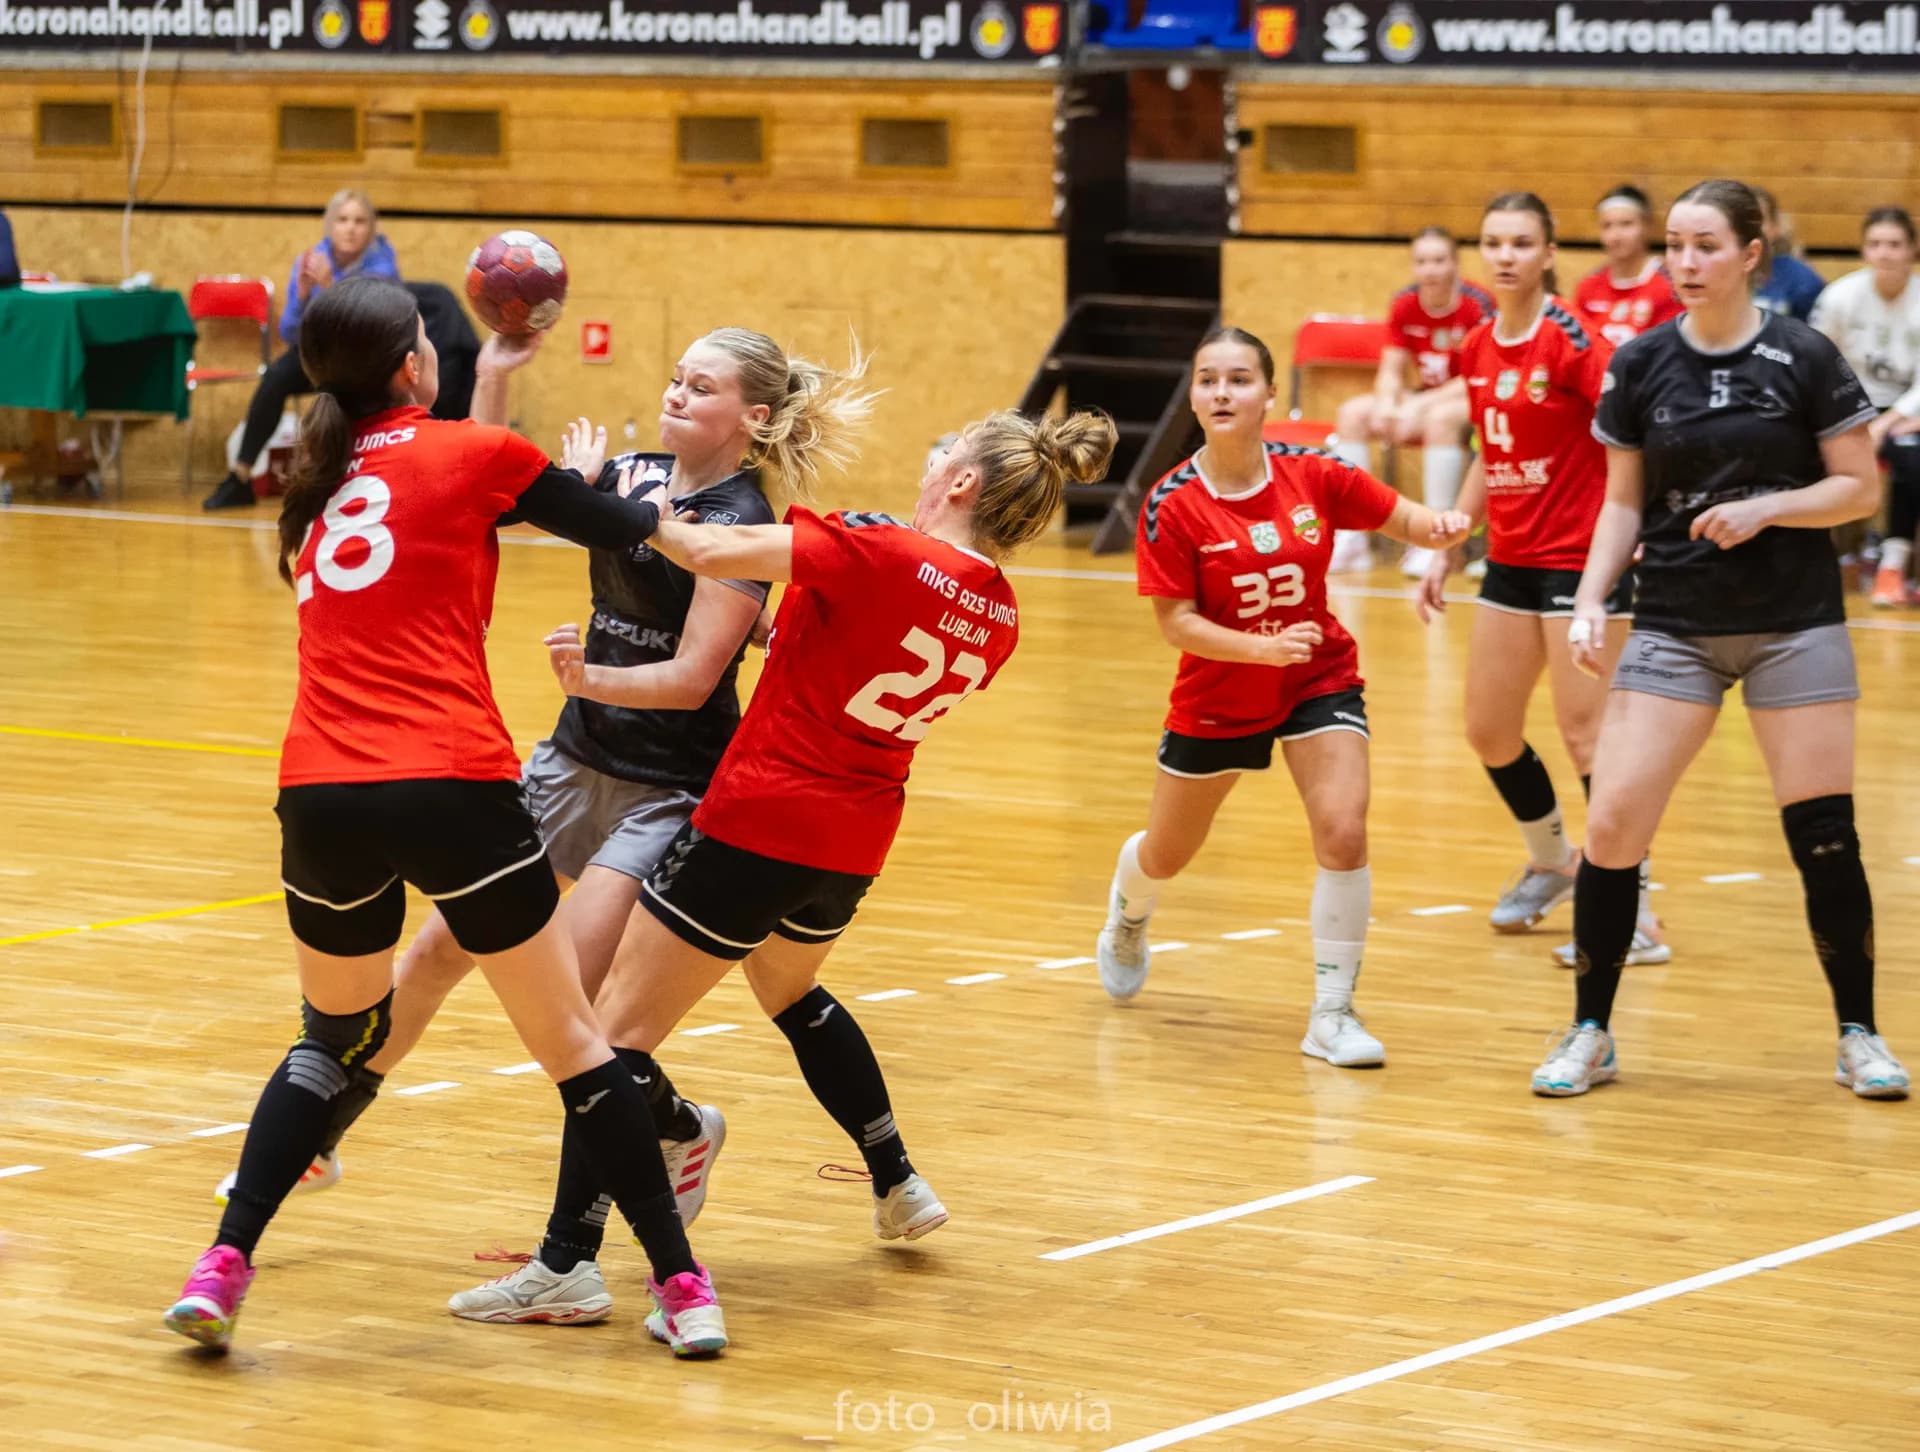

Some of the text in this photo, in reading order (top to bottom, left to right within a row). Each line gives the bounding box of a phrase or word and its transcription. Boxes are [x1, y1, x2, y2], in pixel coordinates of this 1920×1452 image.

[0, 0, 304, 49] koronahandball.pl
[507, 1, 961, 59] www.koronahandball.pl
[1709, 369, 1731, 408] 5
[1484, 407, 1514, 453] 4
[917, 561, 1017, 628] MKS AZS UMCS
[1231, 563, 1306, 619] 33
[937, 610, 991, 647] LUBLIN
[844, 625, 987, 742] 22
